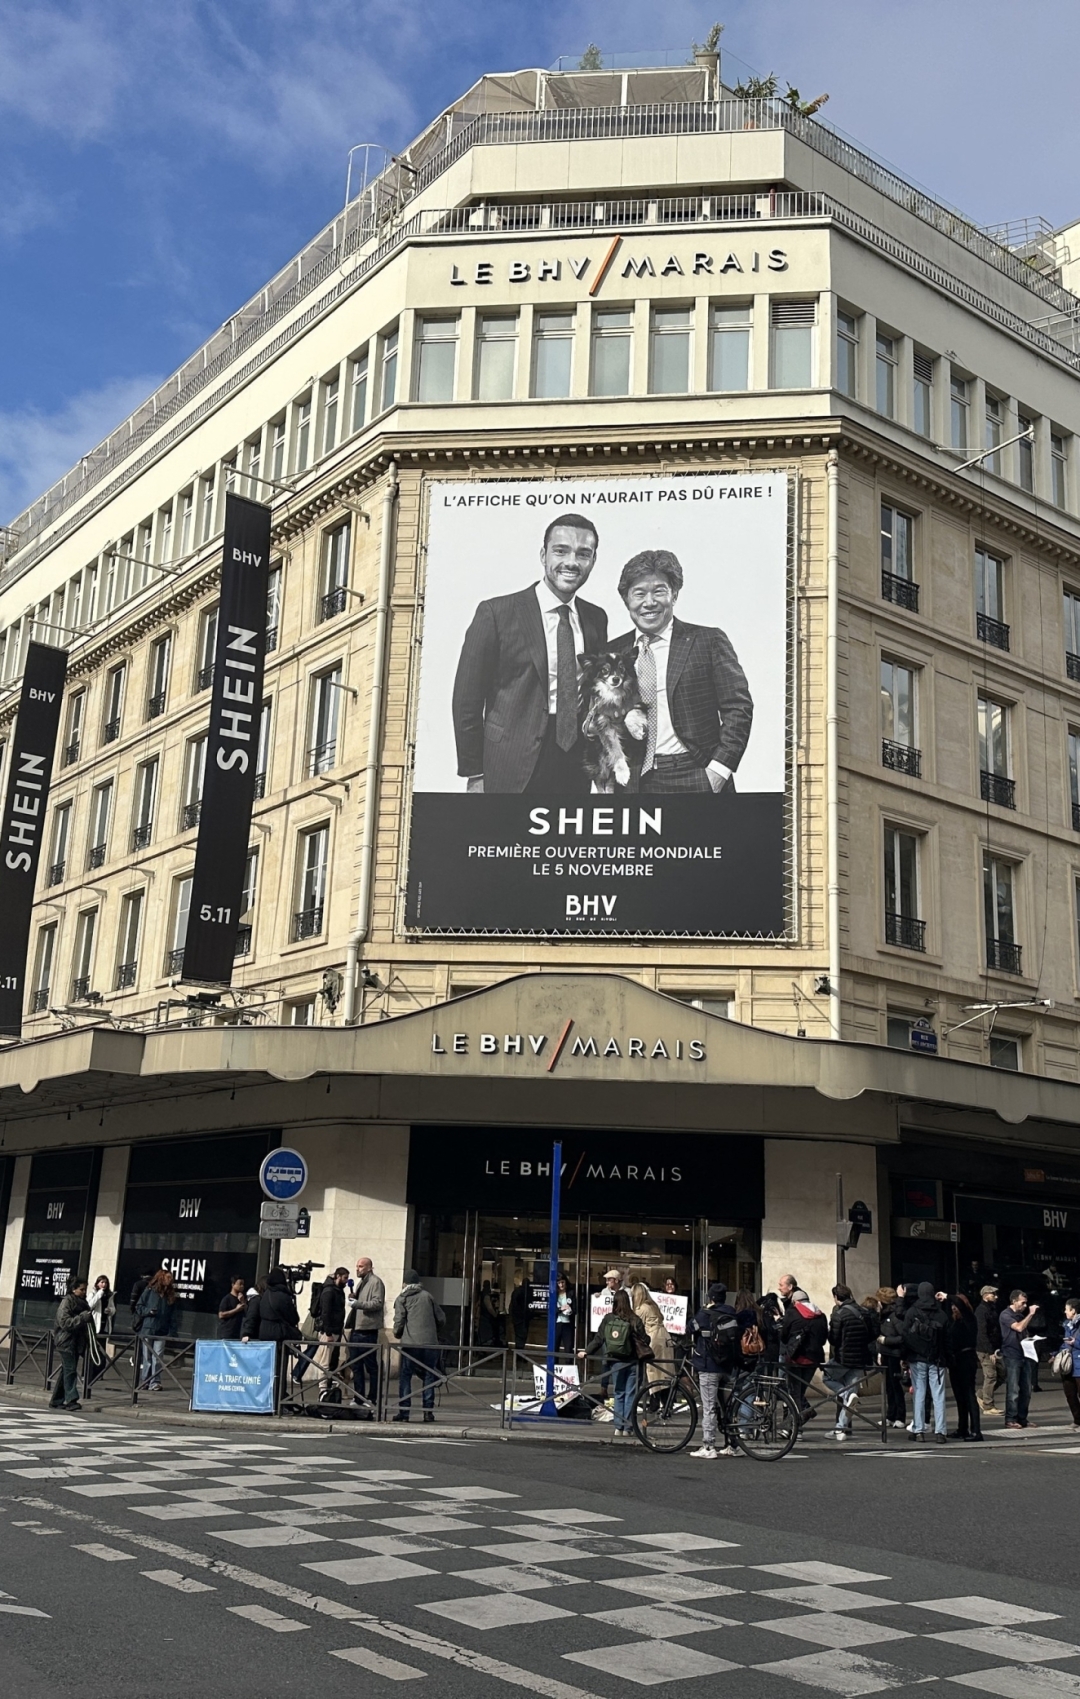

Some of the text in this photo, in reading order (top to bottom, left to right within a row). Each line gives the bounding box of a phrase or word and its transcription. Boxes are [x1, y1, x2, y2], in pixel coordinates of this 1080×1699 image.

[451, 261, 494, 285] LE
[657, 488, 688, 502] PAS
[692, 485, 714, 500] DÛ
[719, 486, 763, 499] FAIRE
[232, 547, 262, 568] BHV
[28, 687, 56, 704] BHV
[216, 624, 259, 775] SHEIN
[5, 752, 47, 873] SHEIN
[528, 807, 662, 836] SHEIN
[468, 843, 722, 859] PREMIÈRE OUVERTURE MONDIALE
[532, 863, 654, 876] LE 5 NOVEMBRE
[199, 903, 232, 926] 5.11
[565, 895, 618, 916] BHV
[0, 976, 17, 990] .11
[431, 1033, 467, 1053] LE
[485, 1160, 510, 1175] LE
[46, 1202, 65, 1220] BHV
[179, 1198, 202, 1218] BHV
[1043, 1209, 1068, 1228] BHV
[21, 1274, 43, 1288] SHEIN
[204, 1374, 218, 1382] ZONE
